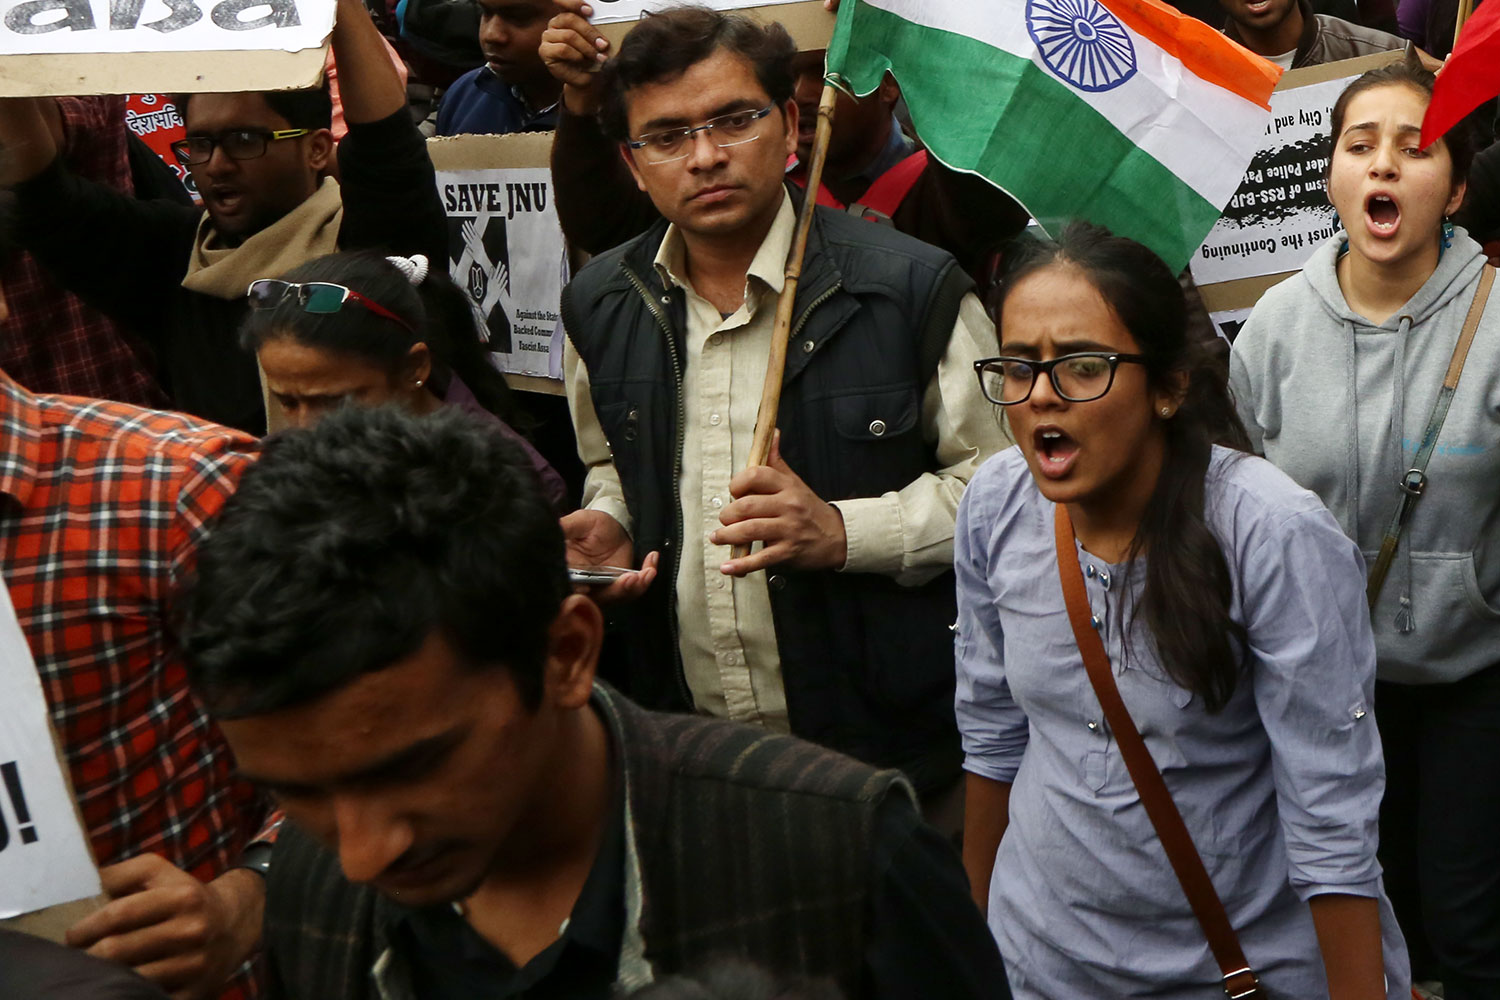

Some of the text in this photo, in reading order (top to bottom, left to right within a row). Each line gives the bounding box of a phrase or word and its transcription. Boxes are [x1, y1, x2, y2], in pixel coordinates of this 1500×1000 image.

[1275, 115, 1294, 133] and
[1299, 109, 1322, 127] City
[1242, 169, 1263, 184] Pat
[1266, 162, 1302, 179] Police
[1230, 187, 1286, 209] RSS-BJP
[1289, 183, 1301, 199] of
[445, 182, 547, 220] SAVE JNU
[1201, 227, 1334, 260] inst the Continuing
[516, 309, 537, 321] Against
[537, 311, 545, 320] the
[514, 324, 534, 335] Backed
[537, 342, 549, 353] Assa
